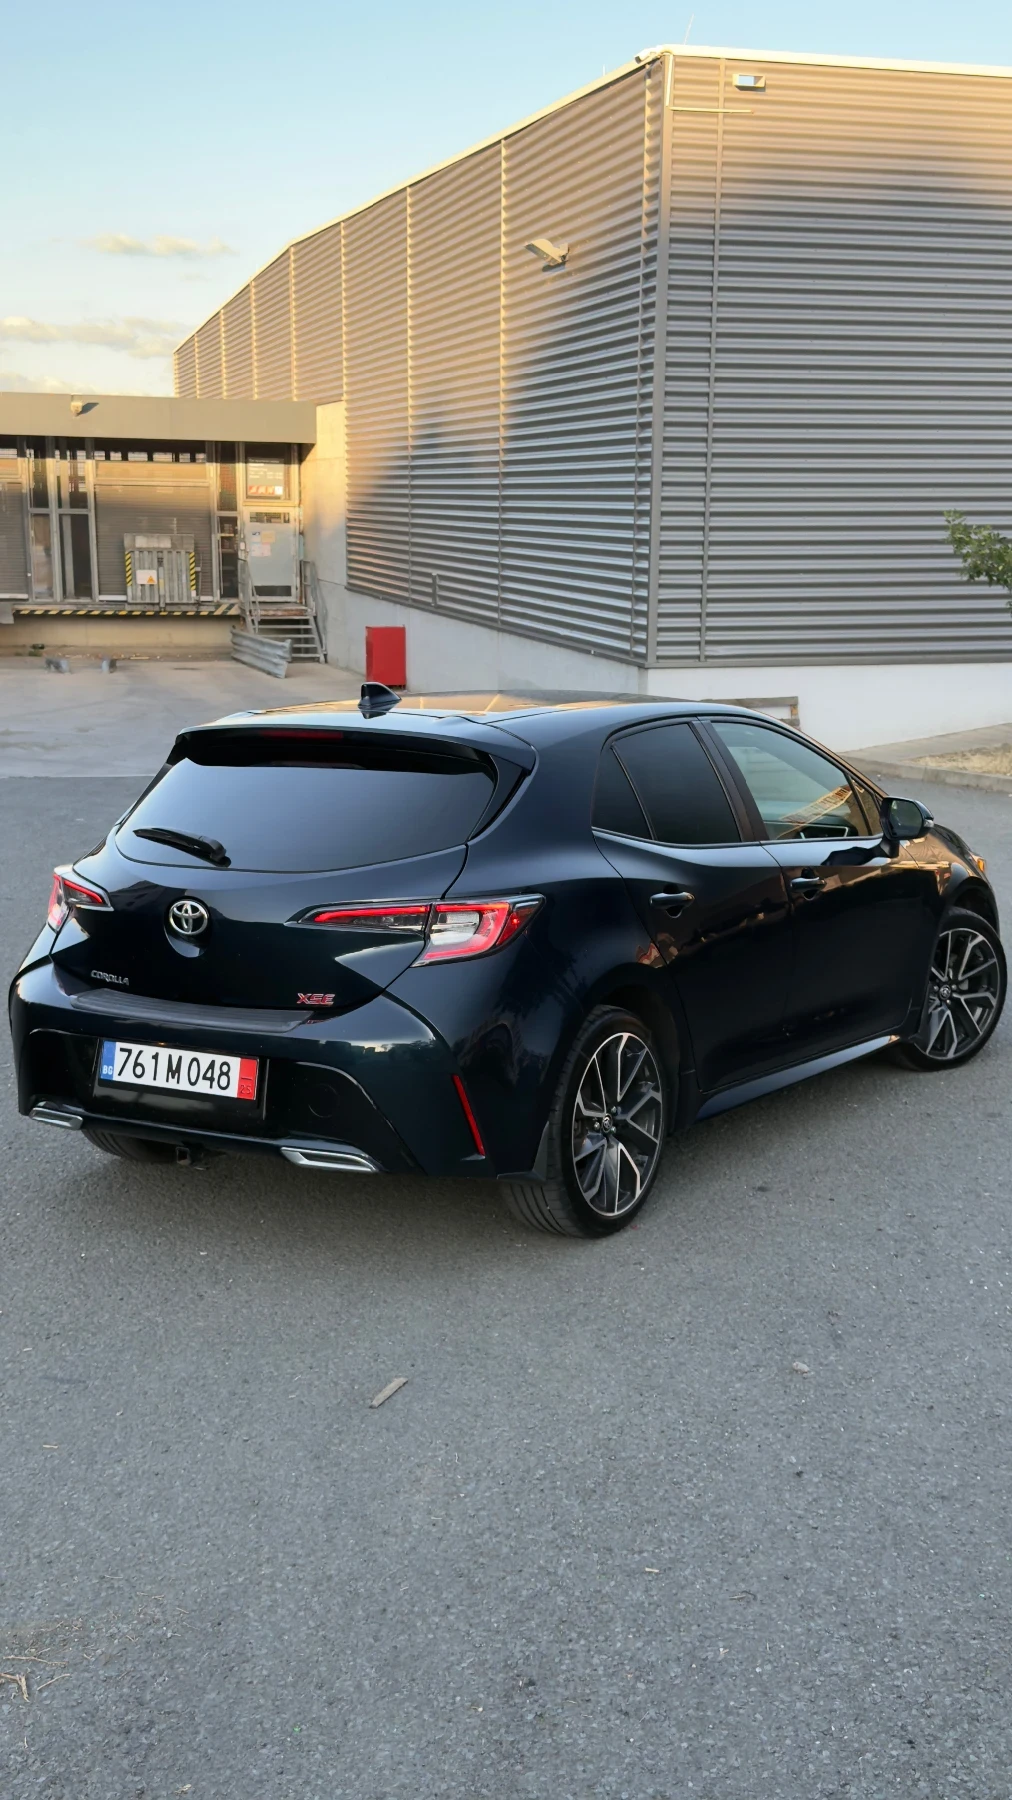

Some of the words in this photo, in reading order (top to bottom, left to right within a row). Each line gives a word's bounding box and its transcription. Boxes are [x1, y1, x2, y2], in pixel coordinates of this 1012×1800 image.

[91, 969, 130, 986] COROLLA
[296, 992, 336, 1006] XSE
[102, 1064, 114, 1075] BG
[117, 1047, 231, 1091] 761M048
